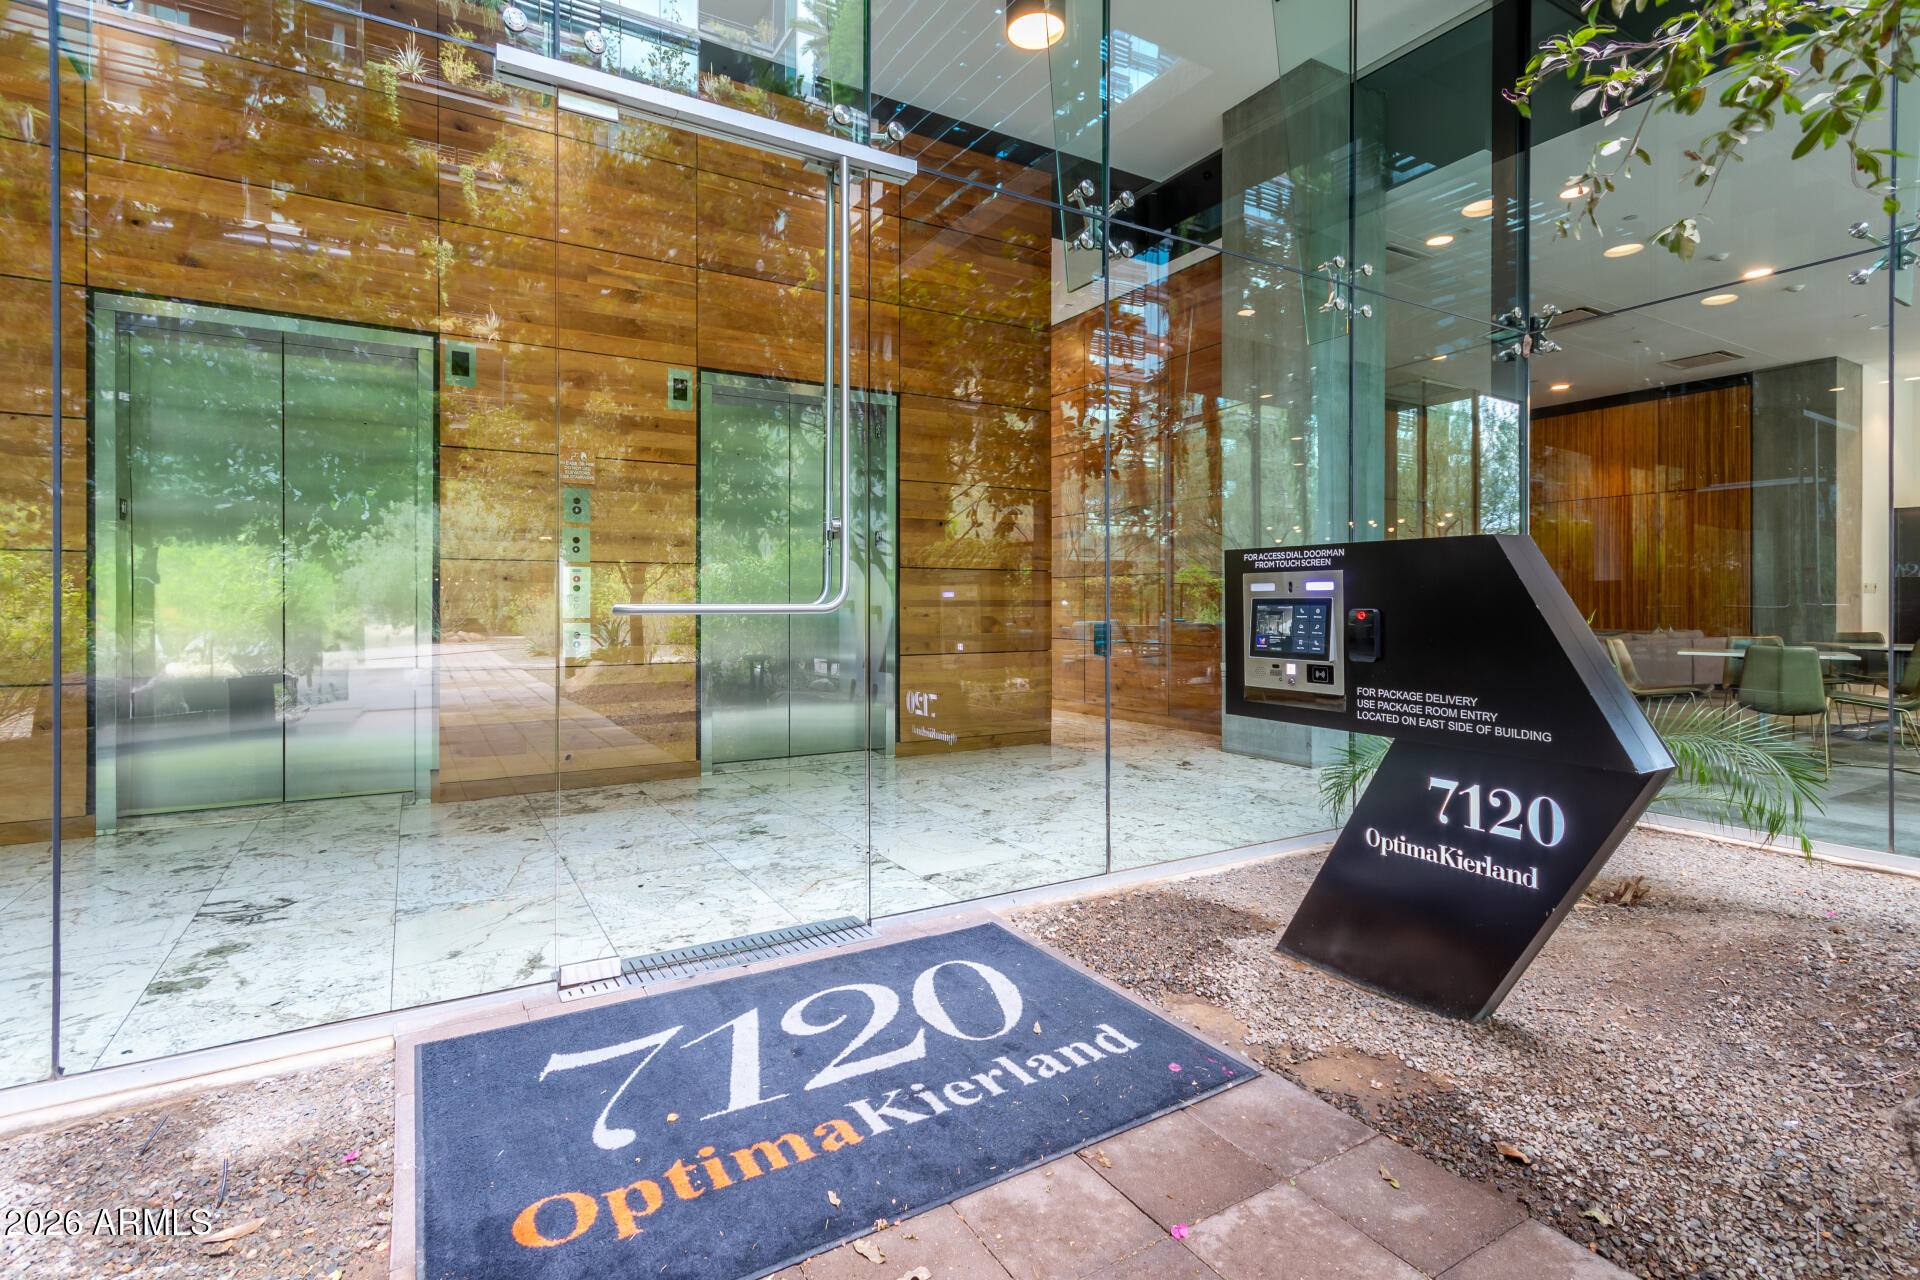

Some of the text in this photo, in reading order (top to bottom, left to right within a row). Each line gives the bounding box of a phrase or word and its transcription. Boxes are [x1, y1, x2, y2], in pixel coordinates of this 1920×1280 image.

[1244, 548, 1345, 561] FOR ACCESS DIAL DOORMAN
[1255, 558, 1331, 568] FROM TOUCH SCREEN
[1356, 686, 1478, 707] FOR PACKAGE DELIVERY
[1357, 699, 1498, 723] USE PACKAGE ROOM ENTRY
[1357, 710, 1552, 743] LOCATED ON EAST SIDE OF BUILDING
[1428, 776, 1566, 847] 7120
[1365, 827, 1540, 890] OptimaKierland
[539, 960, 1023, 1150] 7120
